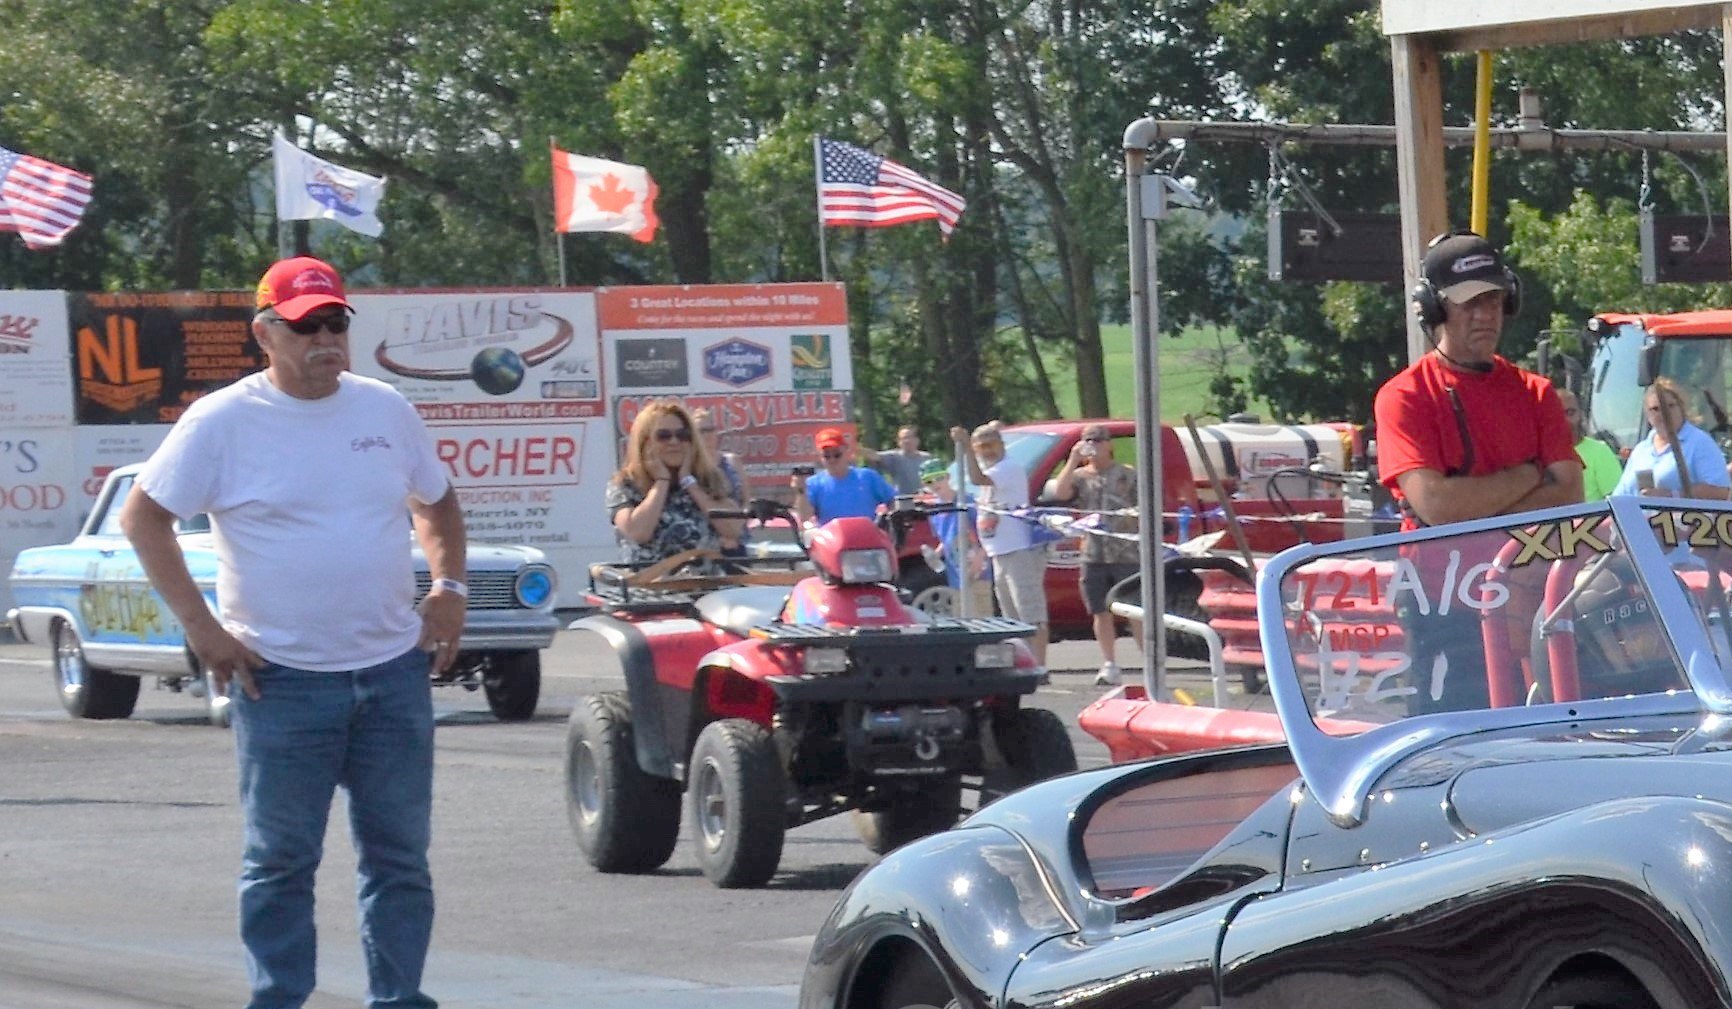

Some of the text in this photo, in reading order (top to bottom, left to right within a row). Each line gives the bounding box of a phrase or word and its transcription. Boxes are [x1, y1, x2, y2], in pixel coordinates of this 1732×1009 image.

[385, 296, 541, 347] DAVIS
[674, 297, 731, 308] Locations
[77, 314, 162, 384] NL
[420, 403, 593, 419] avisTrailerWorld.com
[435, 437, 577, 478] RCHER
[0, 483, 67, 512] OD
[457, 490, 522, 504] RUCTION
[1508, 512, 1615, 568] XK
[1293, 567, 1381, 612] 721
